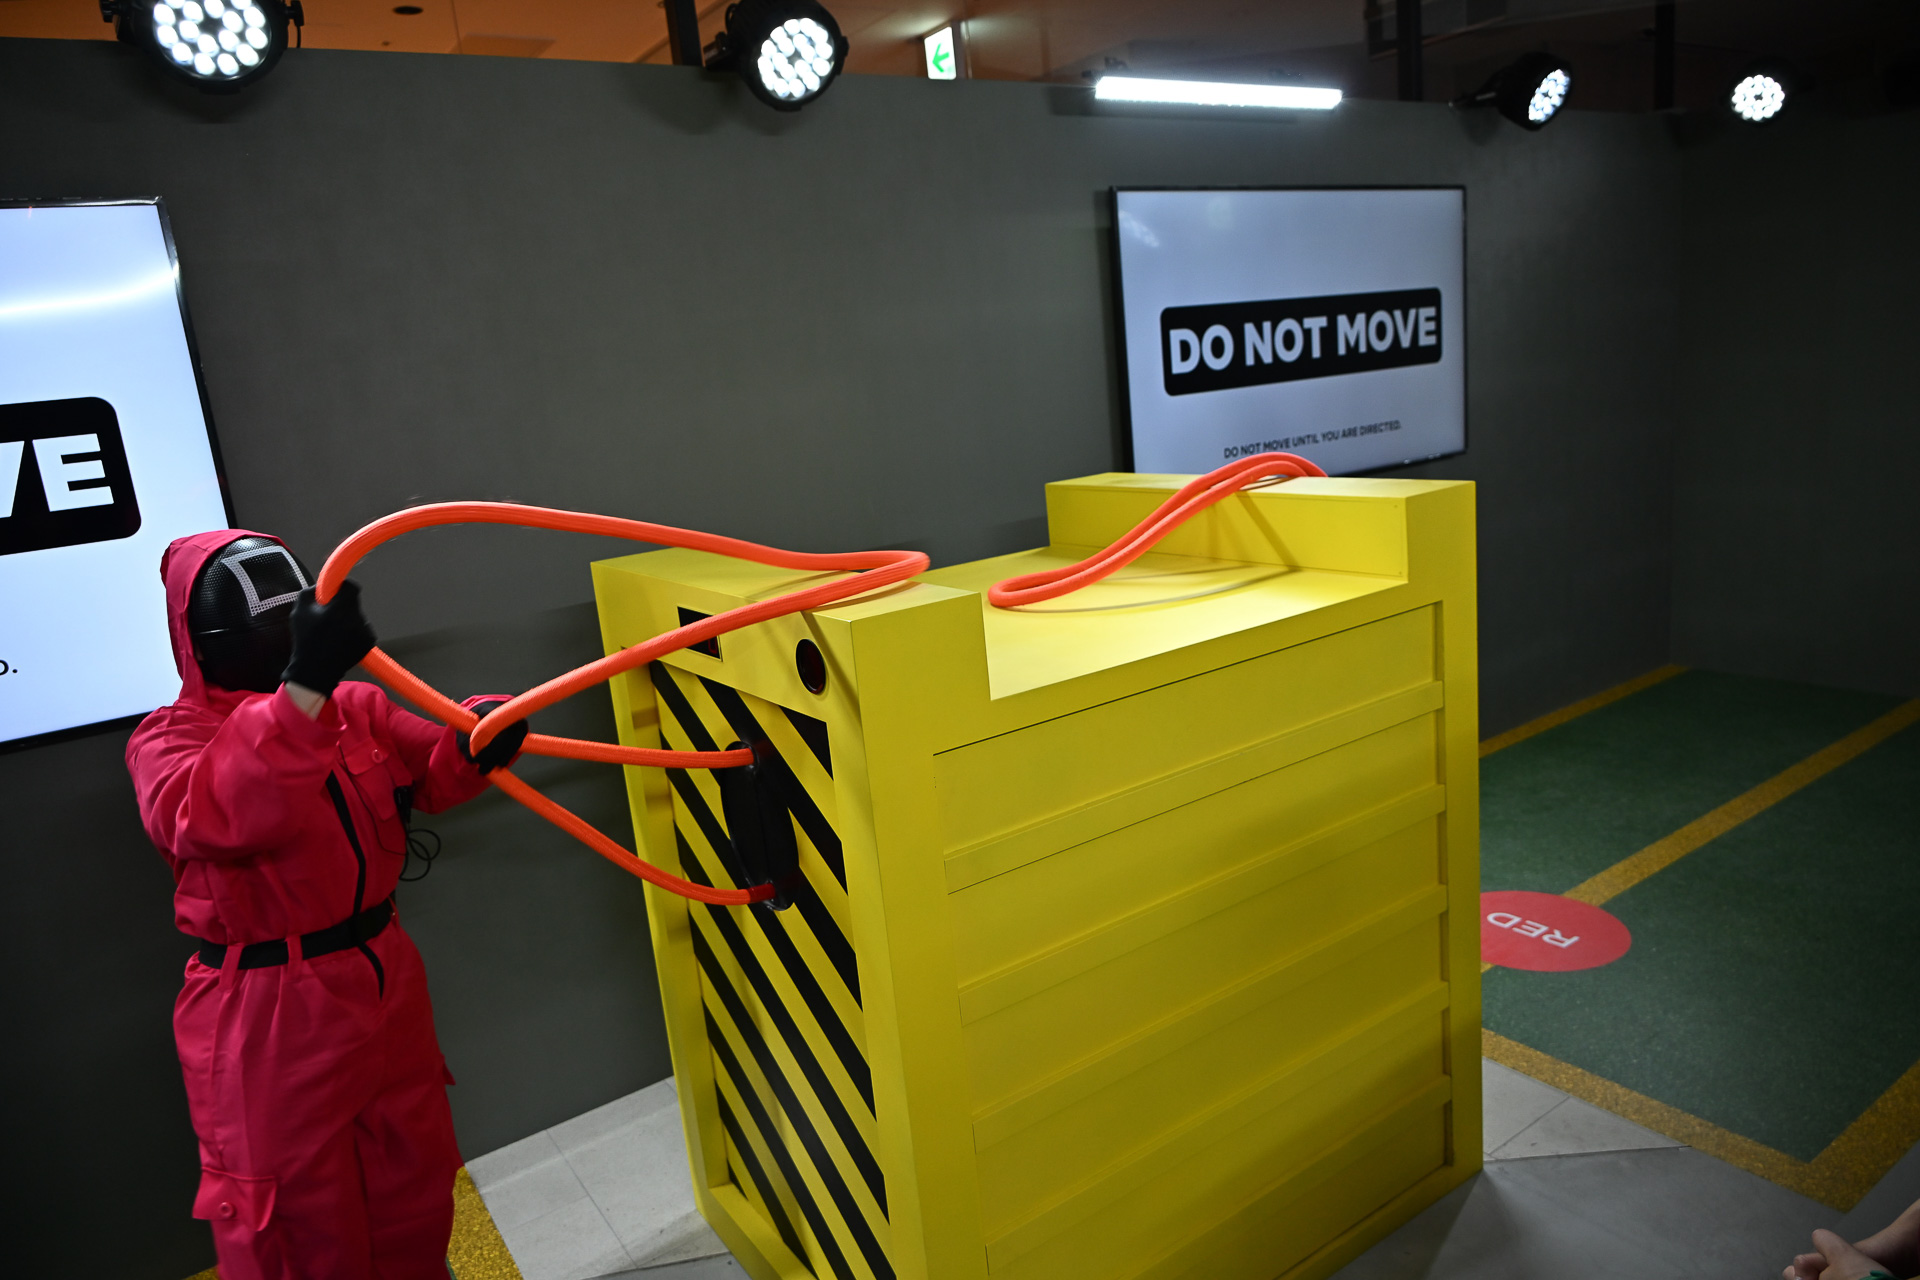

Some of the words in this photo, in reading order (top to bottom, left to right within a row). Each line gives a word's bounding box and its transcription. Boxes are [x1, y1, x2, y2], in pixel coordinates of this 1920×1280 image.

[1169, 324, 1235, 375] DO
[1244, 316, 1328, 367] NOT
[1337, 306, 1437, 356] MOVE
[1223, 446, 1239, 459] DO
[1241, 442, 1261, 455] NOT
[1263, 437, 1290, 451] MOVE
[1292, 433, 1319, 447] UNTIL
[1321, 430, 1340, 442] YOU
[1341, 426, 1358, 438] ARE
[1487, 912, 1580, 948] RED
